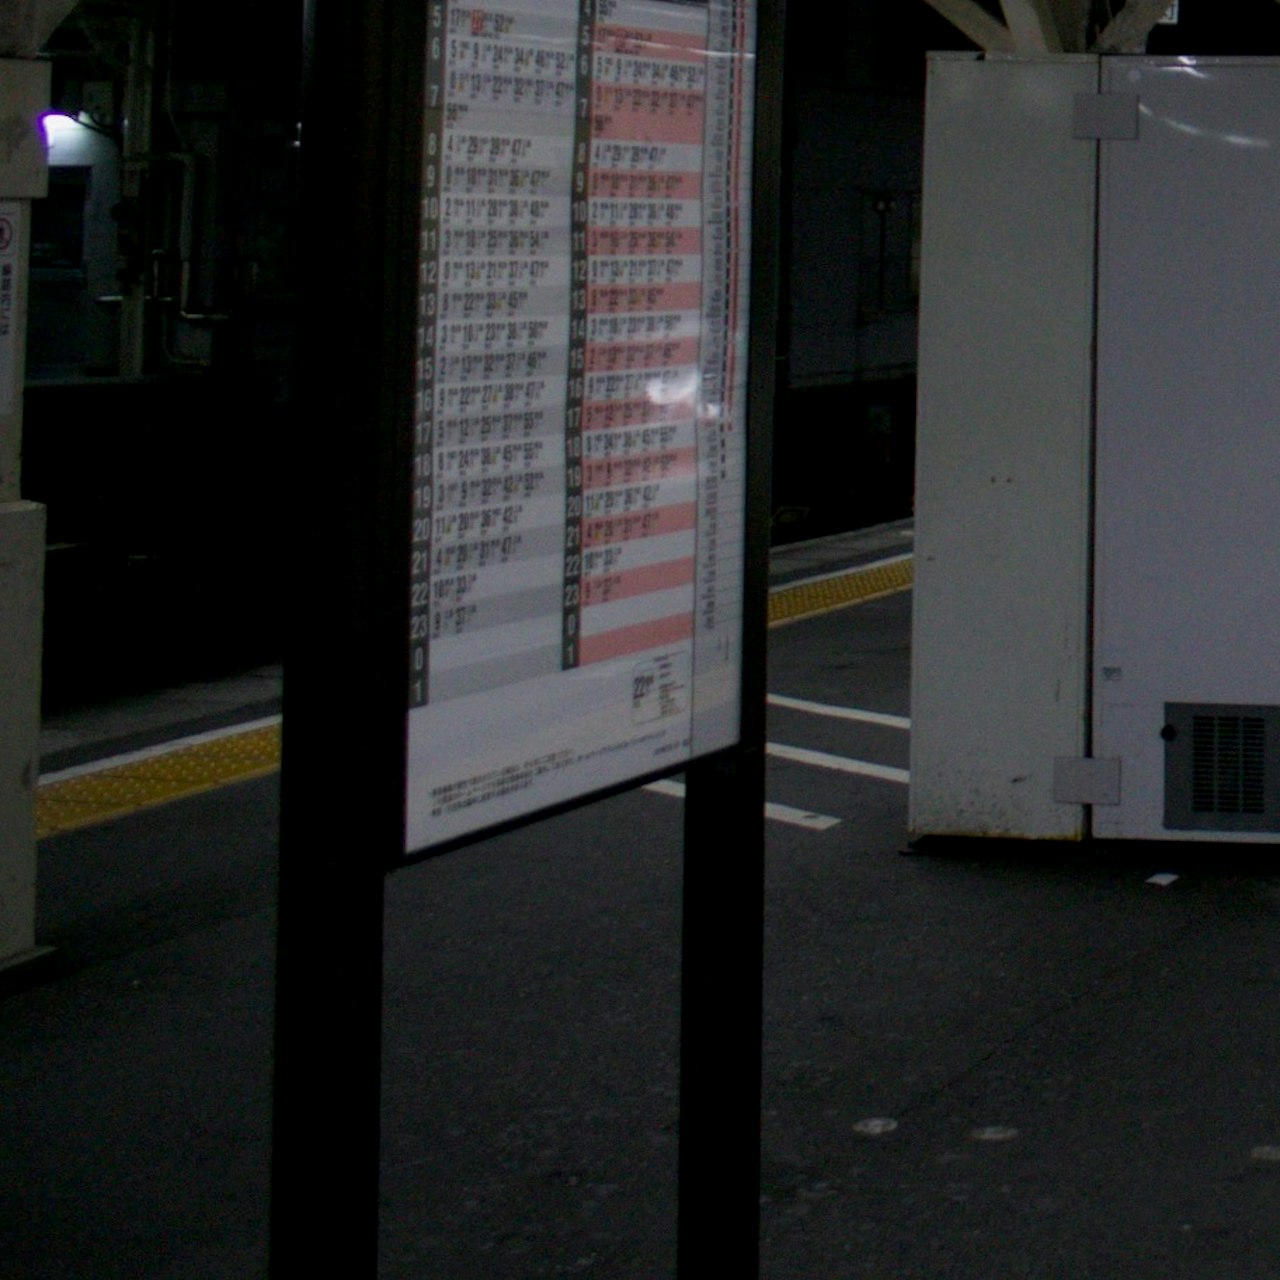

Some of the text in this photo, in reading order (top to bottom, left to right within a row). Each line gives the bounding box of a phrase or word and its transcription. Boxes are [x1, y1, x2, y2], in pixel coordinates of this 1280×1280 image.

[432, 6, 441, 27] 5
[431, 85, 439, 107] 7
[421, 197, 438, 219] 10
[421, 230, 436, 251] 11
[421, 261, 437, 284] 12
[419, 292, 436, 316] 13
[418, 324, 435, 348] 14
[416, 356, 433, 380] 15
[415, 389, 433, 413] 16
[415, 421, 431, 445] 17
[414, 453, 431, 477] 18
[413, 485, 431, 509] 19
[413, 518, 431, 542] 20
[412, 550, 428, 575] 21
[411, 582, 428, 607] 22
[411, 614, 428, 640] 23
[414, 681, 422, 702] 1
